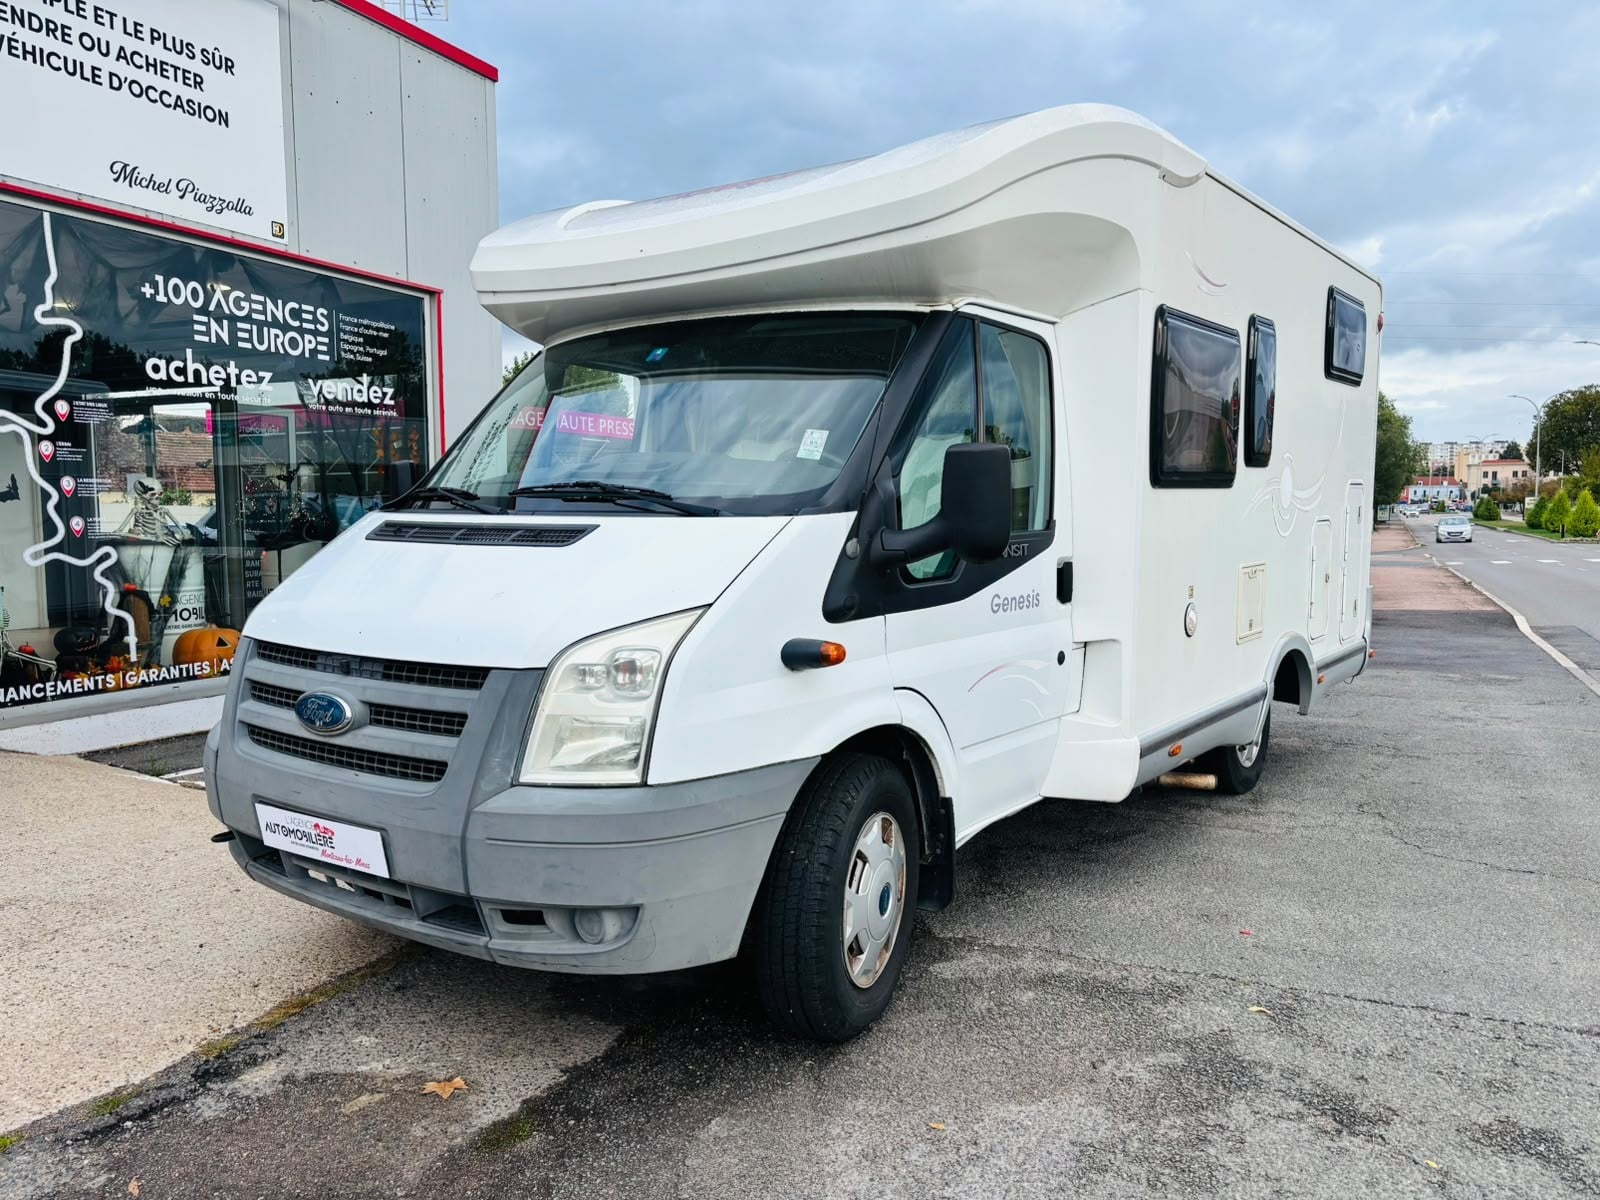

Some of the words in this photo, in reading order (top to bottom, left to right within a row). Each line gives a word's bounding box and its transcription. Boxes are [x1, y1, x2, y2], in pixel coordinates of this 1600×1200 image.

[93, 5, 118, 30] ET
[122, 16, 145, 41] LE
[149, 27, 196, 60] PLUS
[200, 47, 235, 76] SÛR
[78, 31, 110, 57] OU
[115, 46, 204, 92] ACHETER
[109, 160, 172, 195] Michel
[175, 178, 254, 216] Piazzolla
[140, 274, 204, 308] +100
[208, 286, 329, 333] AGENCES
[339, 313, 357, 323] France
[339, 322, 358, 332] France
[192, 314, 230, 345] EN
[237, 322, 330, 361] EUROPE
[145, 348, 273, 391] achetez
[307, 373, 396, 405] vendez
[308, 403, 327, 411] votre
[354, 406, 372, 415] toute
[1003, 543, 1029, 558] NSIT
[990, 589, 1040, 614] Genesis
[125, 661, 210, 684] GARANTIES
[303, 698, 335, 723] Ford
